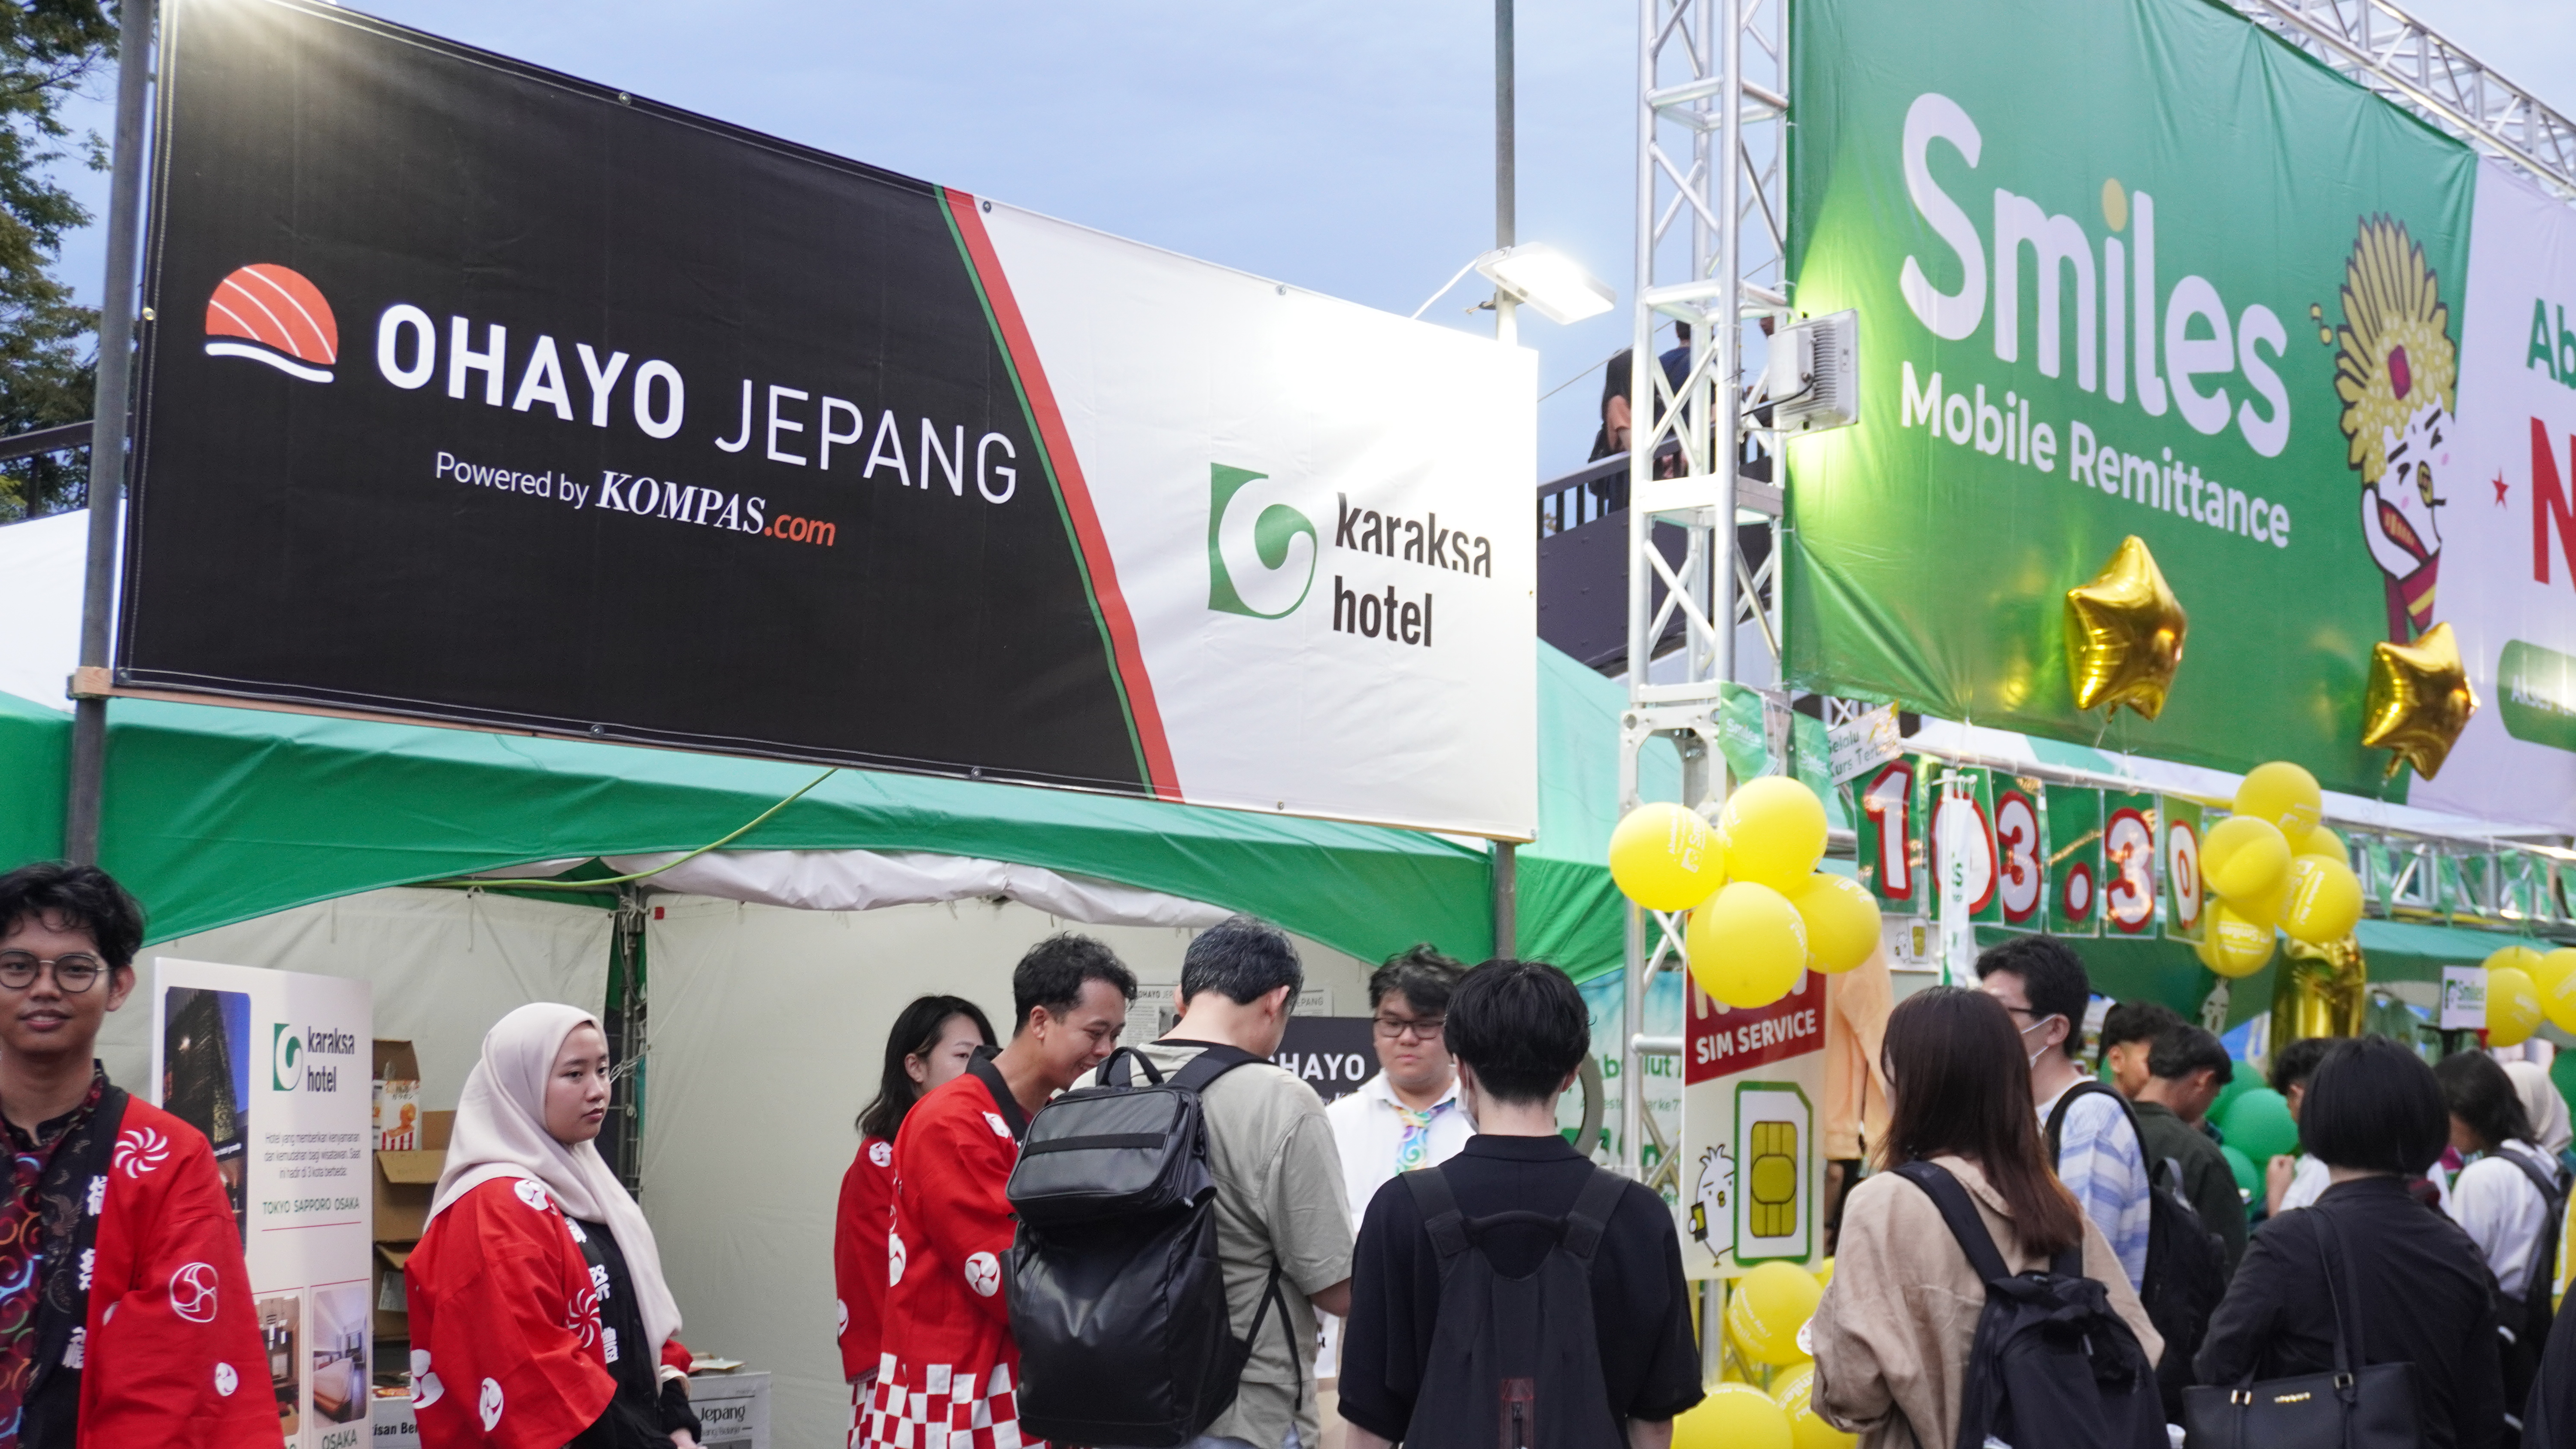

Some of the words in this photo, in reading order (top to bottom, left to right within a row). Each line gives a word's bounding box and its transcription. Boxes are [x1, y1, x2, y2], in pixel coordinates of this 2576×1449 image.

[1899, 92, 2291, 458] Smiles
[377, 303, 685, 439] OHAYO
[714, 379, 1017, 504] JEPANG
[1901, 360, 2057, 473] Mobile
[2069, 419, 2290, 548] Remittance
[436, 451, 552, 498] Powered
[559, 473, 590, 510] by
[595, 470, 836, 547] KOMPAS.com
[1335, 491, 1492, 579] karaksa
[1333, 575, 1433, 647] hotel
[307, 1026, 355, 1055] karaksa
[1696, 1031, 1734, 1065] SIM
[1737, 1009, 1817, 1053] SERVICE
[307, 1065, 337, 1092] hotel
[1268, 1052, 1365, 1081] HAYO
[262, 1200, 290, 1215] TOKYO
[294, 1197, 332, 1213] SAPPORO
[334, 1197, 360, 1210] OSAKA
[322, 1429, 357, 1449] OSAKA
[700, 1405, 746, 1423] Jepang
